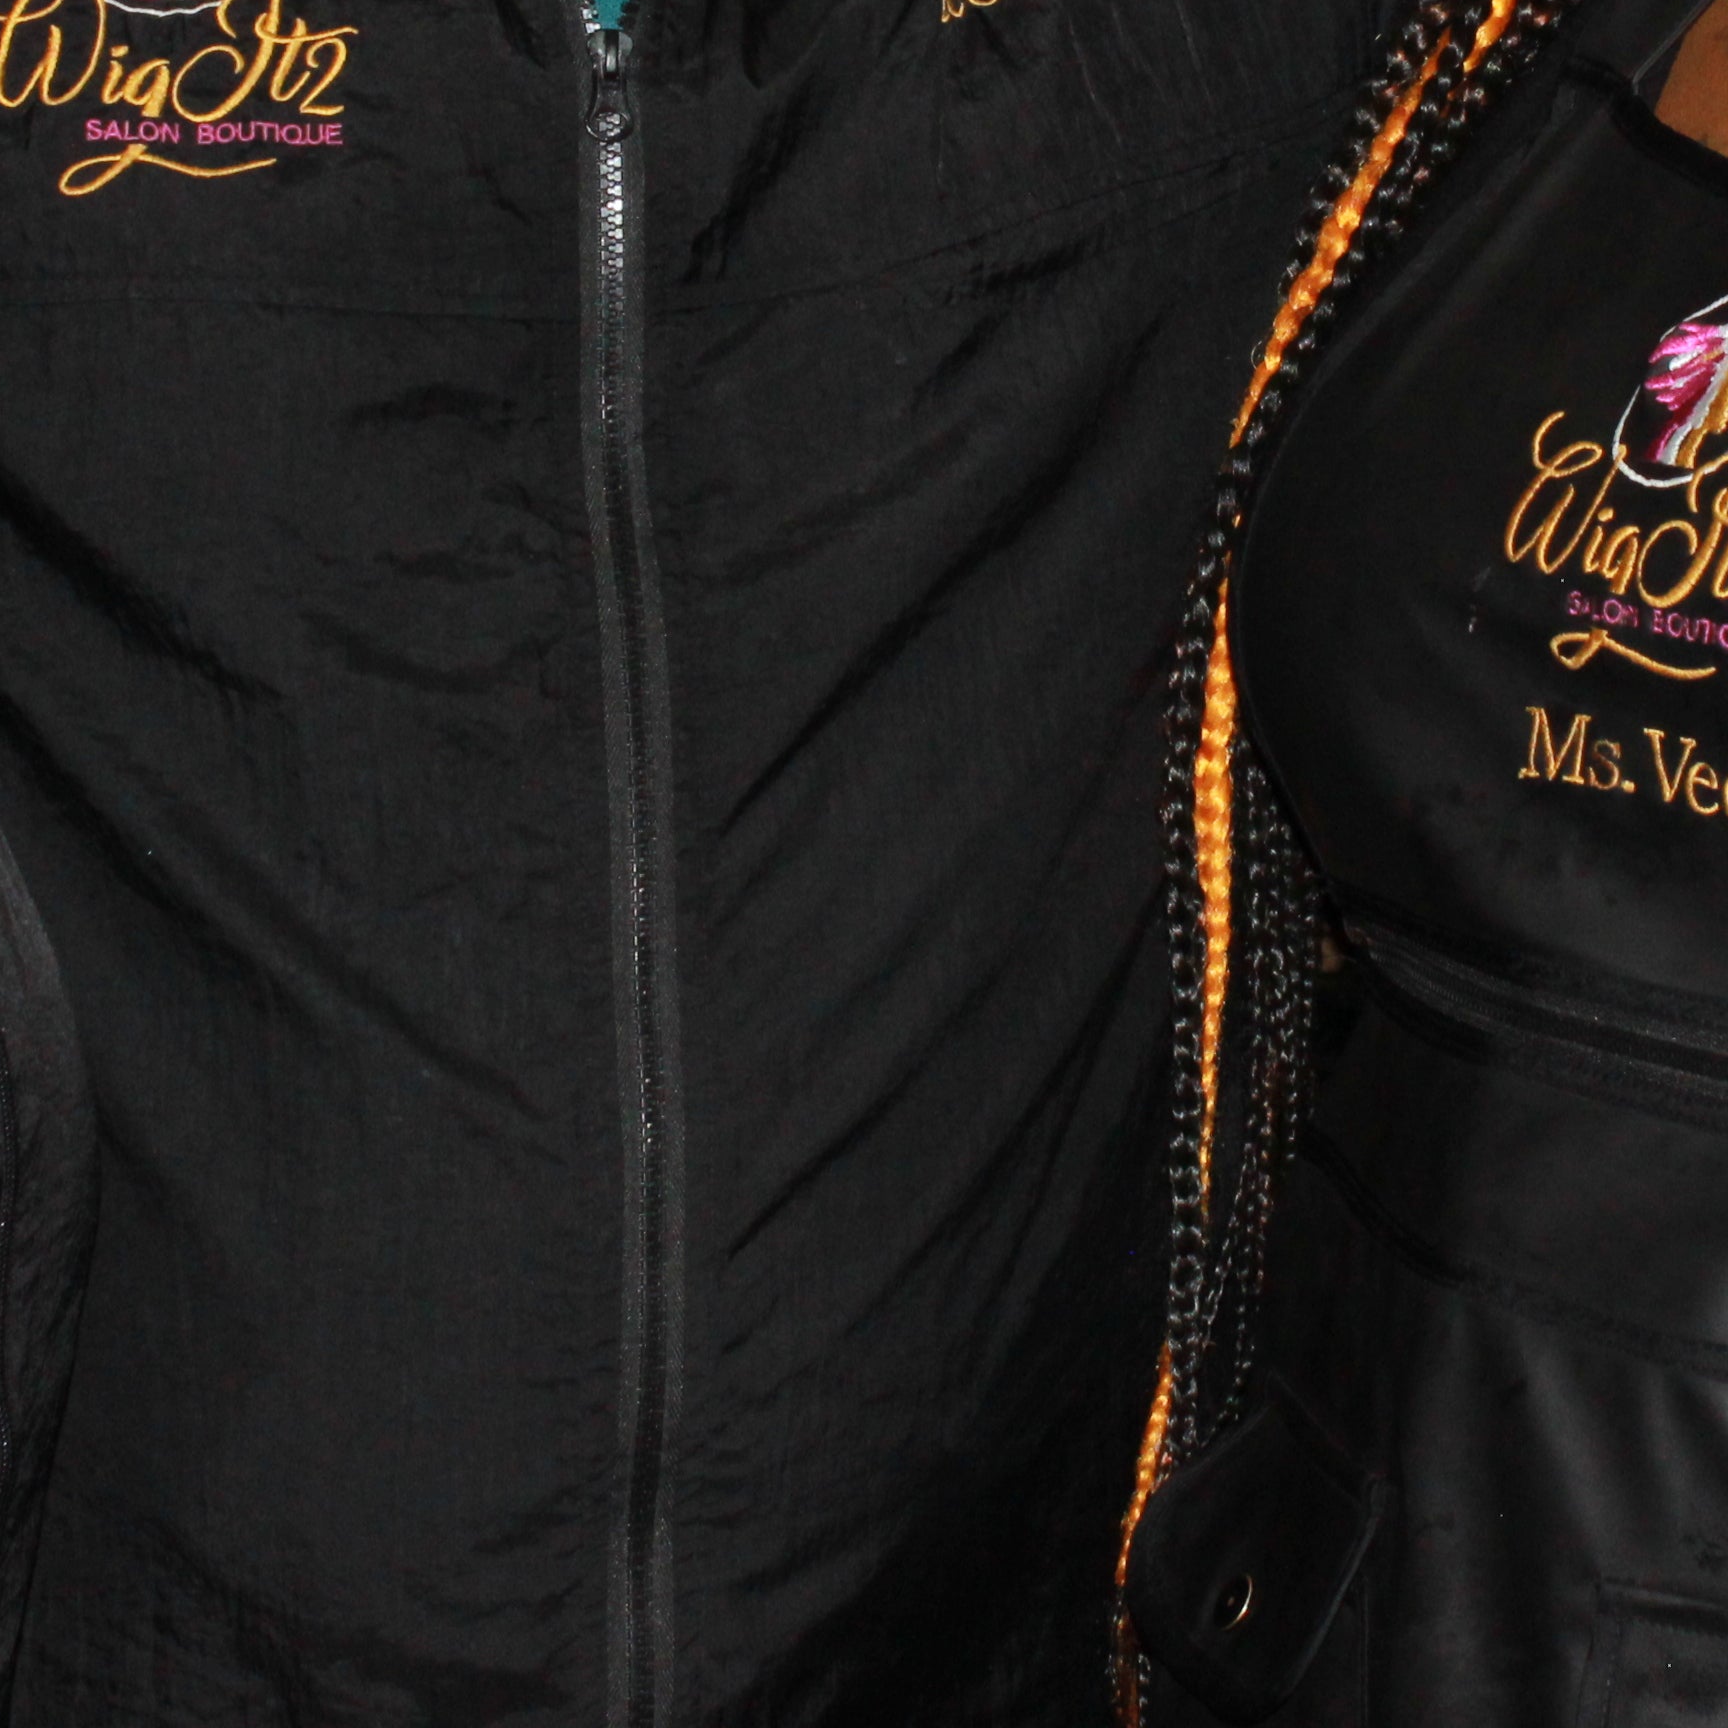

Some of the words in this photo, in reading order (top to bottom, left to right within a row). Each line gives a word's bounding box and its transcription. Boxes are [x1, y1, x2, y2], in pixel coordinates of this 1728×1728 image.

[84, 118, 181, 144] SALON
[197, 119, 344, 146] BOUTIQUE
[1518, 705, 1636, 796] Ms.
